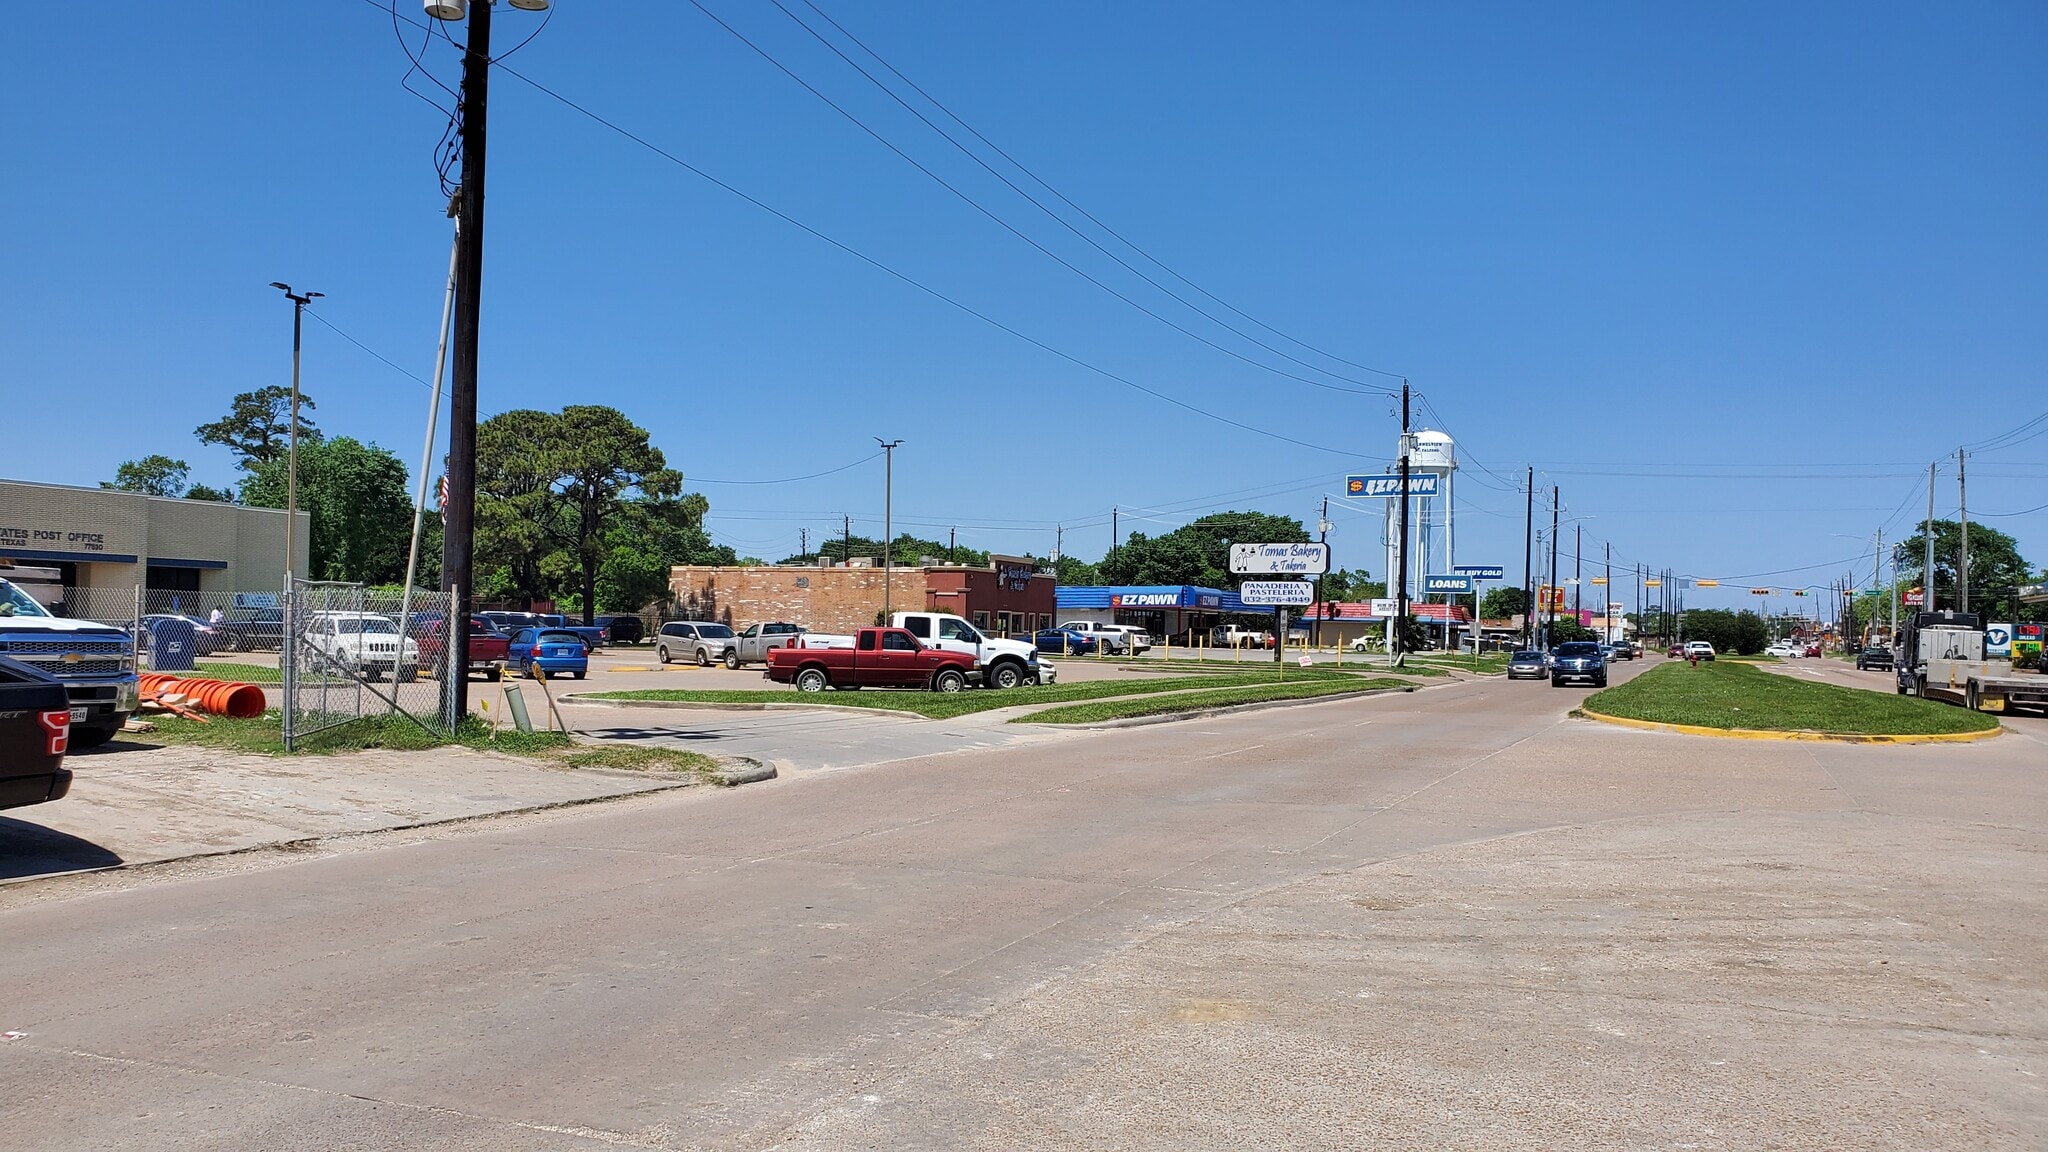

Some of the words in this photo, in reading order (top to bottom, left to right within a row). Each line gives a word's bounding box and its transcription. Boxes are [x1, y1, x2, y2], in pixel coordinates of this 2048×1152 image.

[34, 530, 62, 541] POST
[67, 532, 104, 543] OFFICE
[1, 538, 26, 546] TEXAS
[1258, 543, 1288, 557] Tomas
[1290, 542, 1321, 563] Bakery
[1270, 561, 1279, 571] &
[1429, 580, 1467, 589] LOANS
